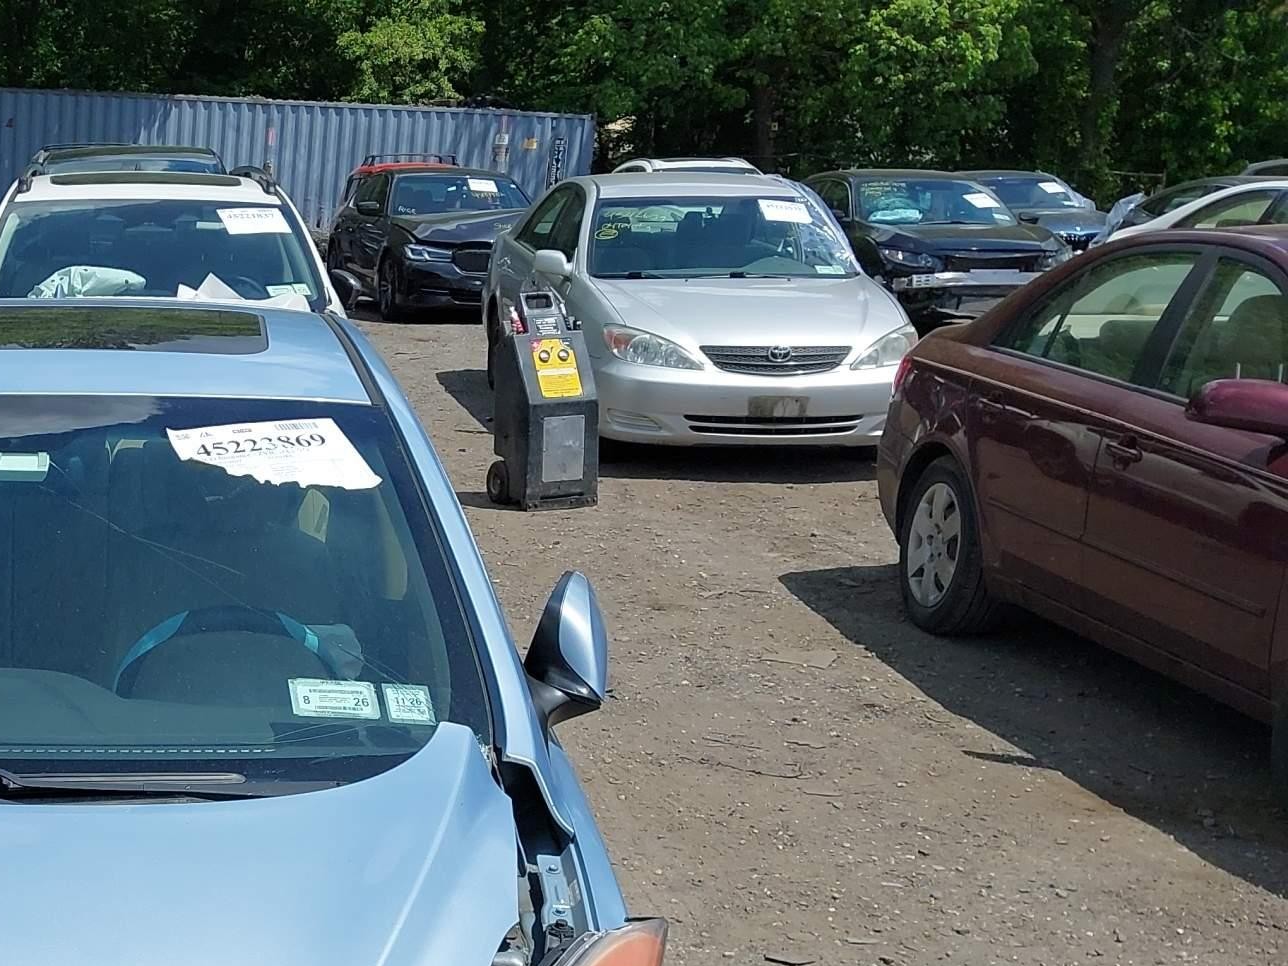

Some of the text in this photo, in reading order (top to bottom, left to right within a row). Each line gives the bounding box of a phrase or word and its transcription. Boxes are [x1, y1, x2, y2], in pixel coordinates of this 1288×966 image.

[197, 433, 326, 457] 45223869
[303, 695, 311, 705] 8
[353, 697, 370, 707] 26
